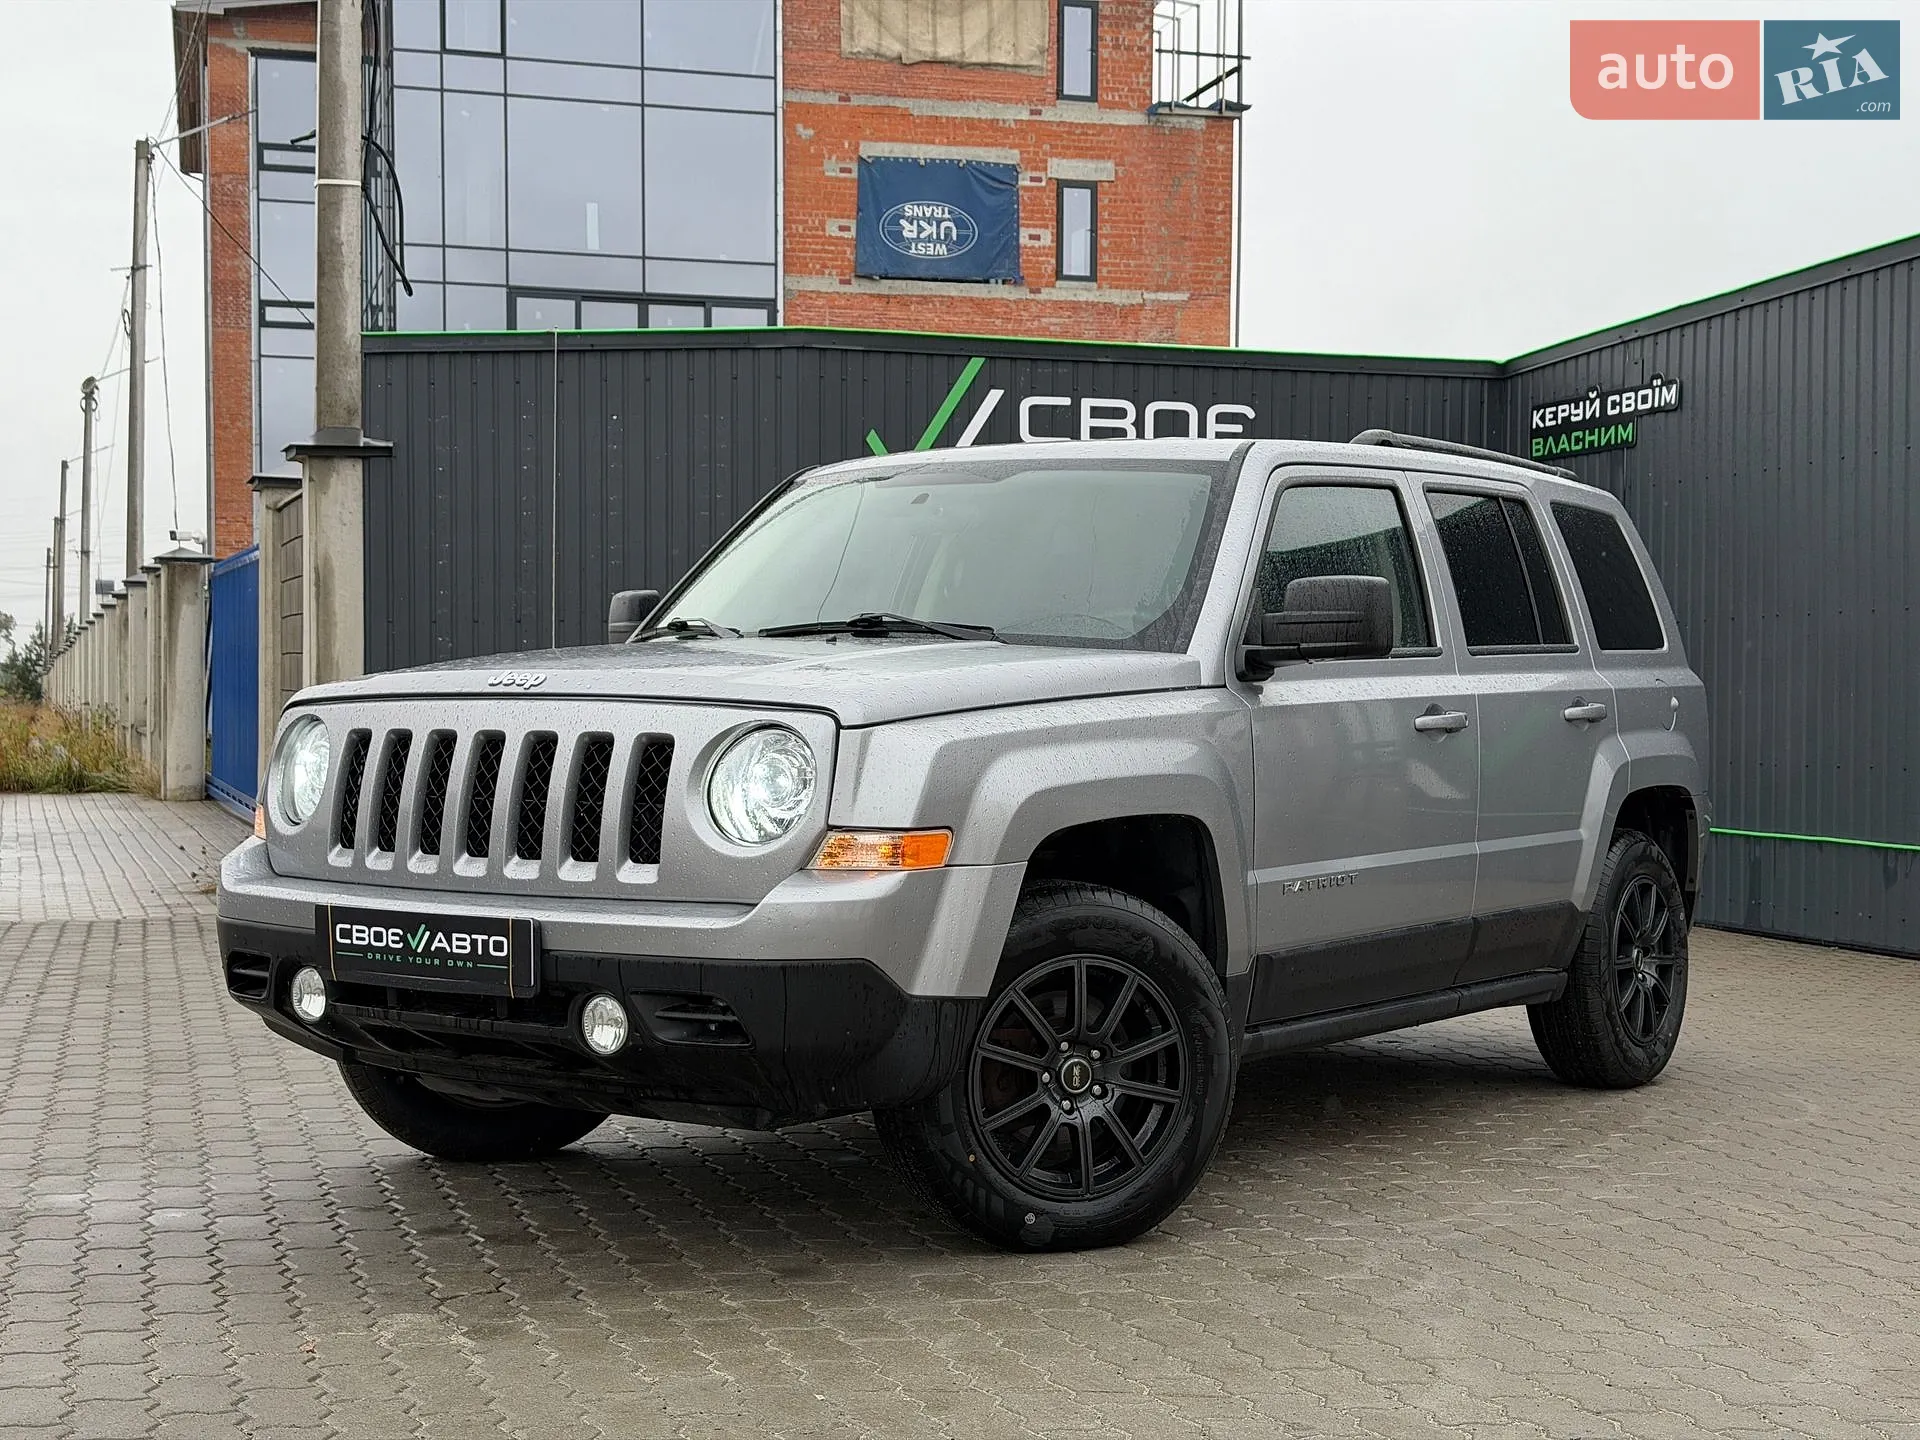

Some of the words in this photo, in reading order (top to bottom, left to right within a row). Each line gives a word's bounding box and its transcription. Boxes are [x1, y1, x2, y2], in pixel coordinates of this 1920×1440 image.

[904, 204, 952, 218] TRANS
[899, 218, 957, 241] UKR
[909, 242, 948, 256] WEST
[1532, 390, 1600, 429] КЕРУЙ
[1607, 379, 1677, 416] СВОЇМ
[1532, 422, 1633, 457] ВЛАСНИМ
[488, 670, 547, 690] Jeep
[1282, 872, 1359, 896] PATRIOT
[430, 931, 508, 957] АВТО
[367, 952, 402, 962] DRIVE
[408, 956, 440, 966] YOUR
[447, 959, 473, 968] OWN
